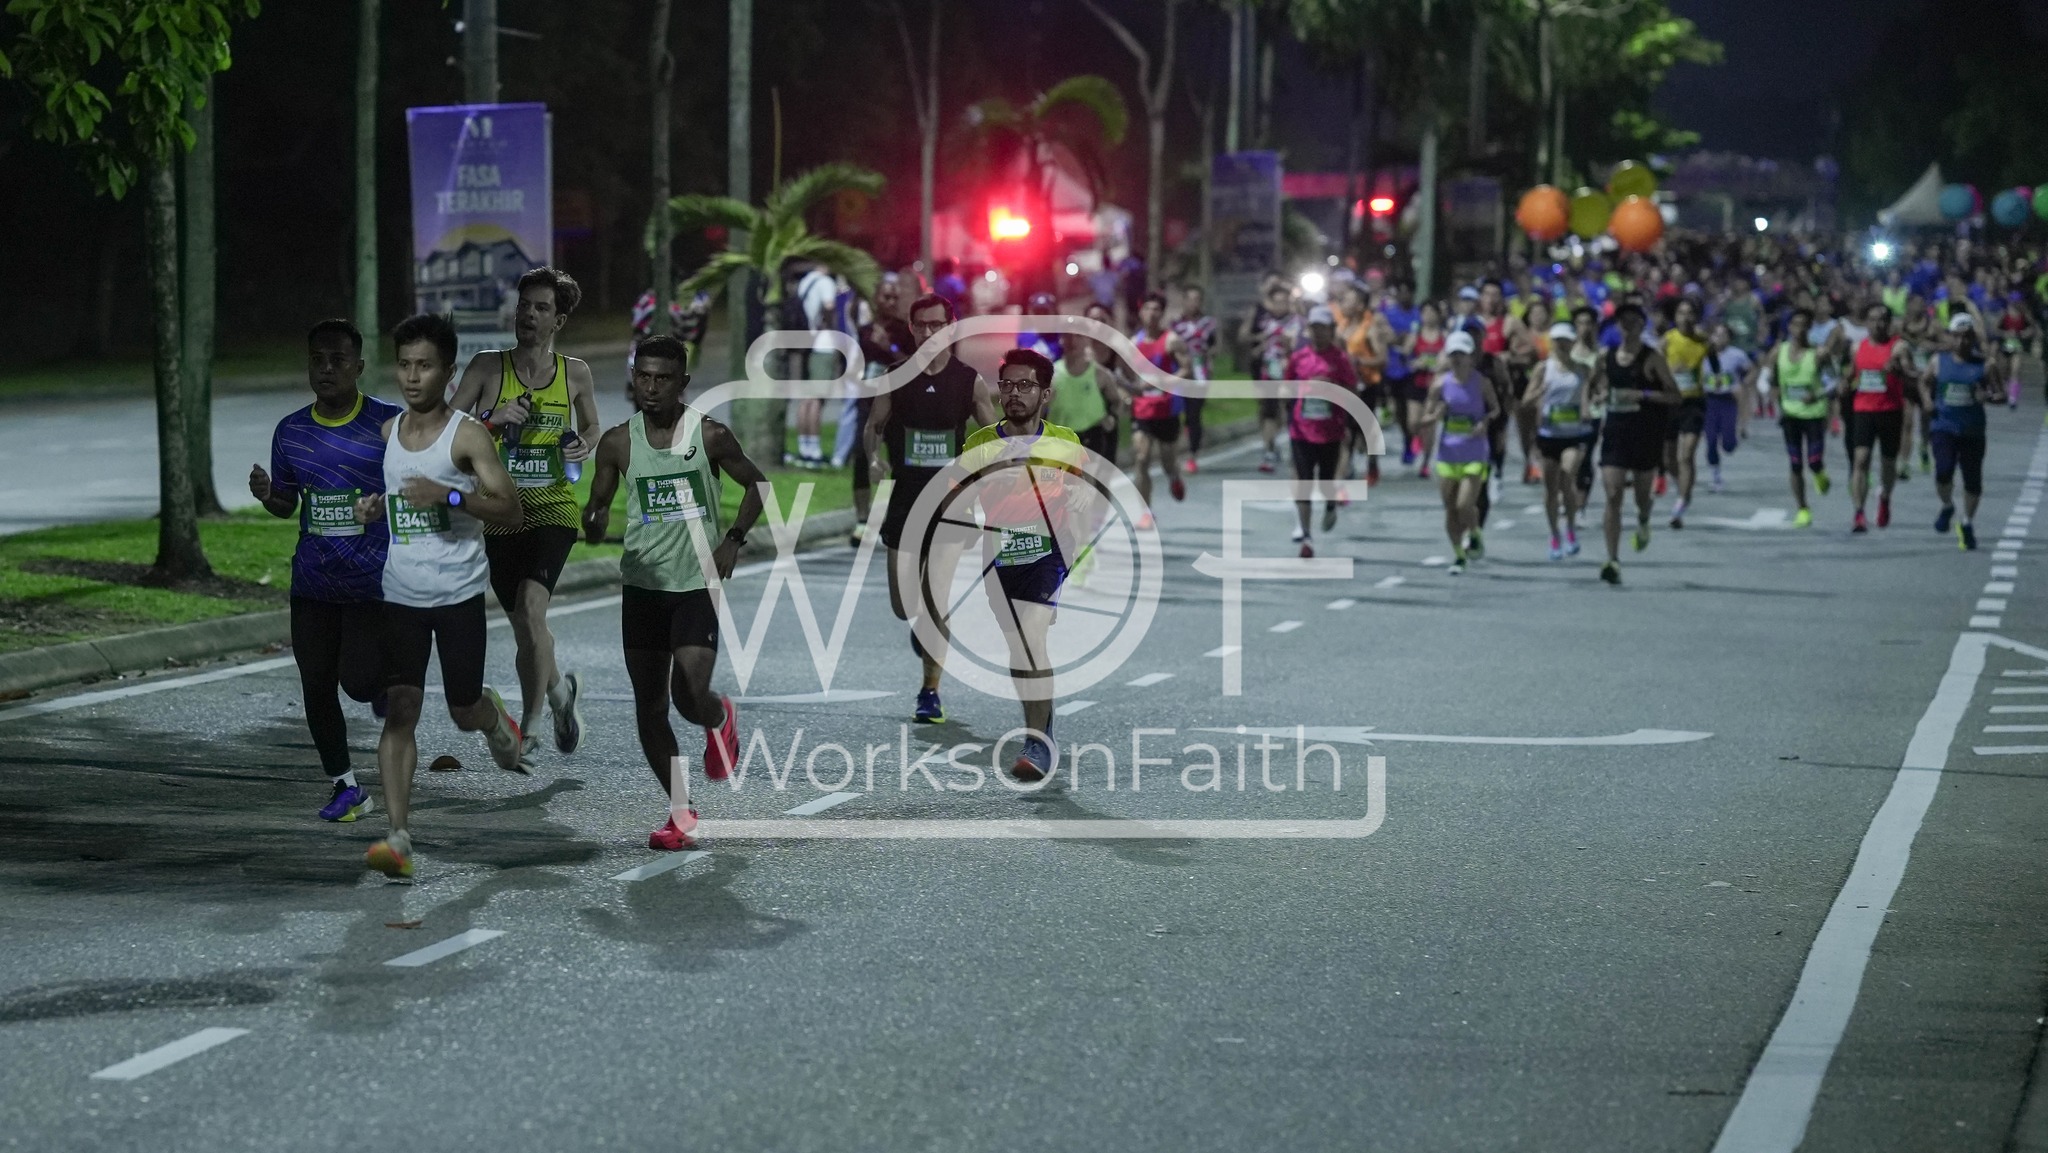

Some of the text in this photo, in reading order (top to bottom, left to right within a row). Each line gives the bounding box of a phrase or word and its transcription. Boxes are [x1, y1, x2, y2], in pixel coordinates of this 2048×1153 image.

[913, 443, 948, 454] E2318
[508, 459, 548, 473] F4019
[647, 488, 694, 507] F4487
[310, 506, 354, 521] E2563
[1000, 535, 1043, 552] E2599
